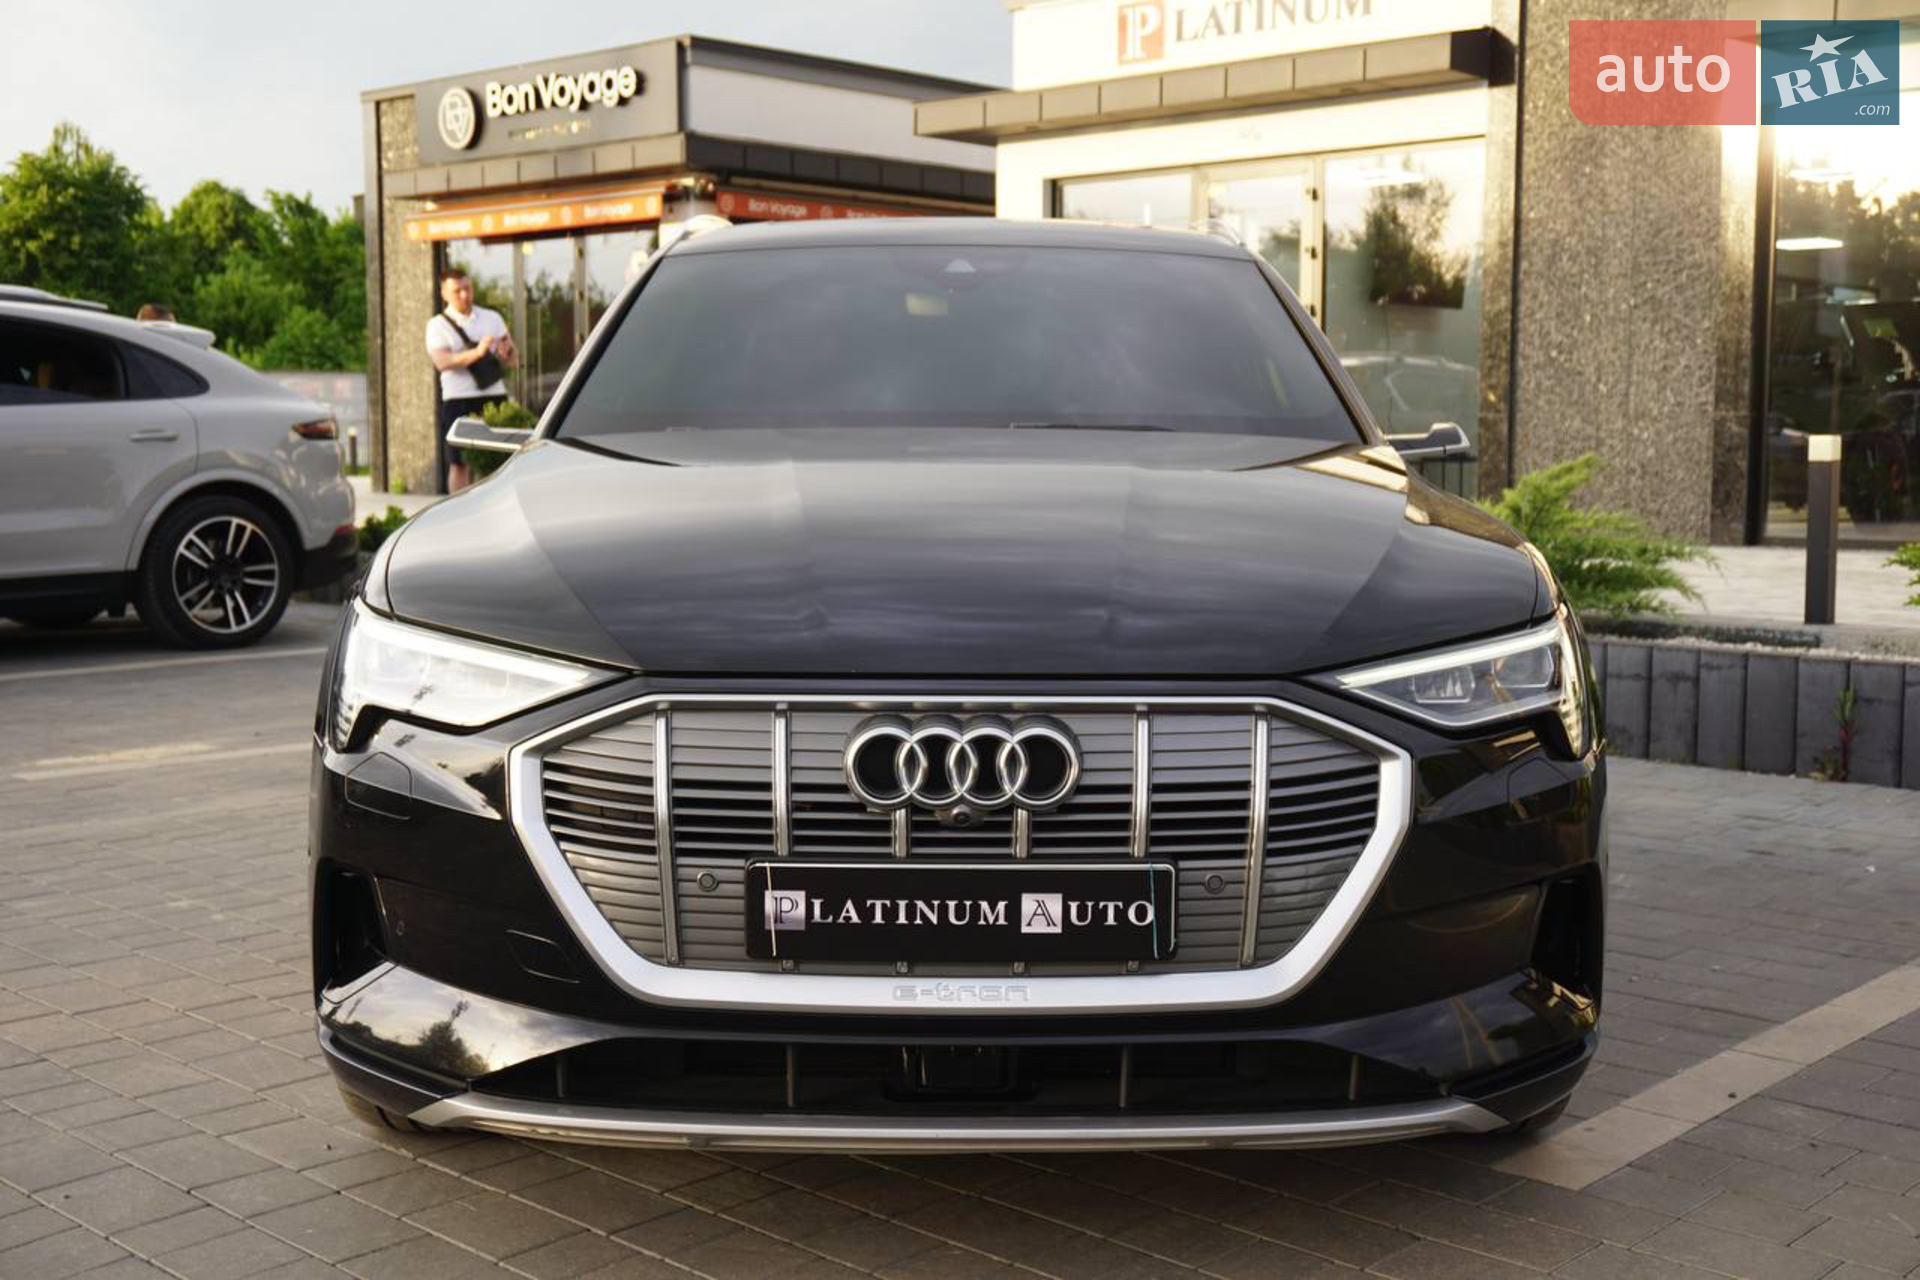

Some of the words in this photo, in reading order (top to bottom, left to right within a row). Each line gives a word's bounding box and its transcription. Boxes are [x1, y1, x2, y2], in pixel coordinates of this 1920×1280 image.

[485, 81, 536, 118] Bon
[536, 66, 637, 113] Voyage
[768, 893, 1009, 928] PLATINUM
[1023, 896, 1156, 930] AUTO
[892, 982, 1029, 1002] e-tron
